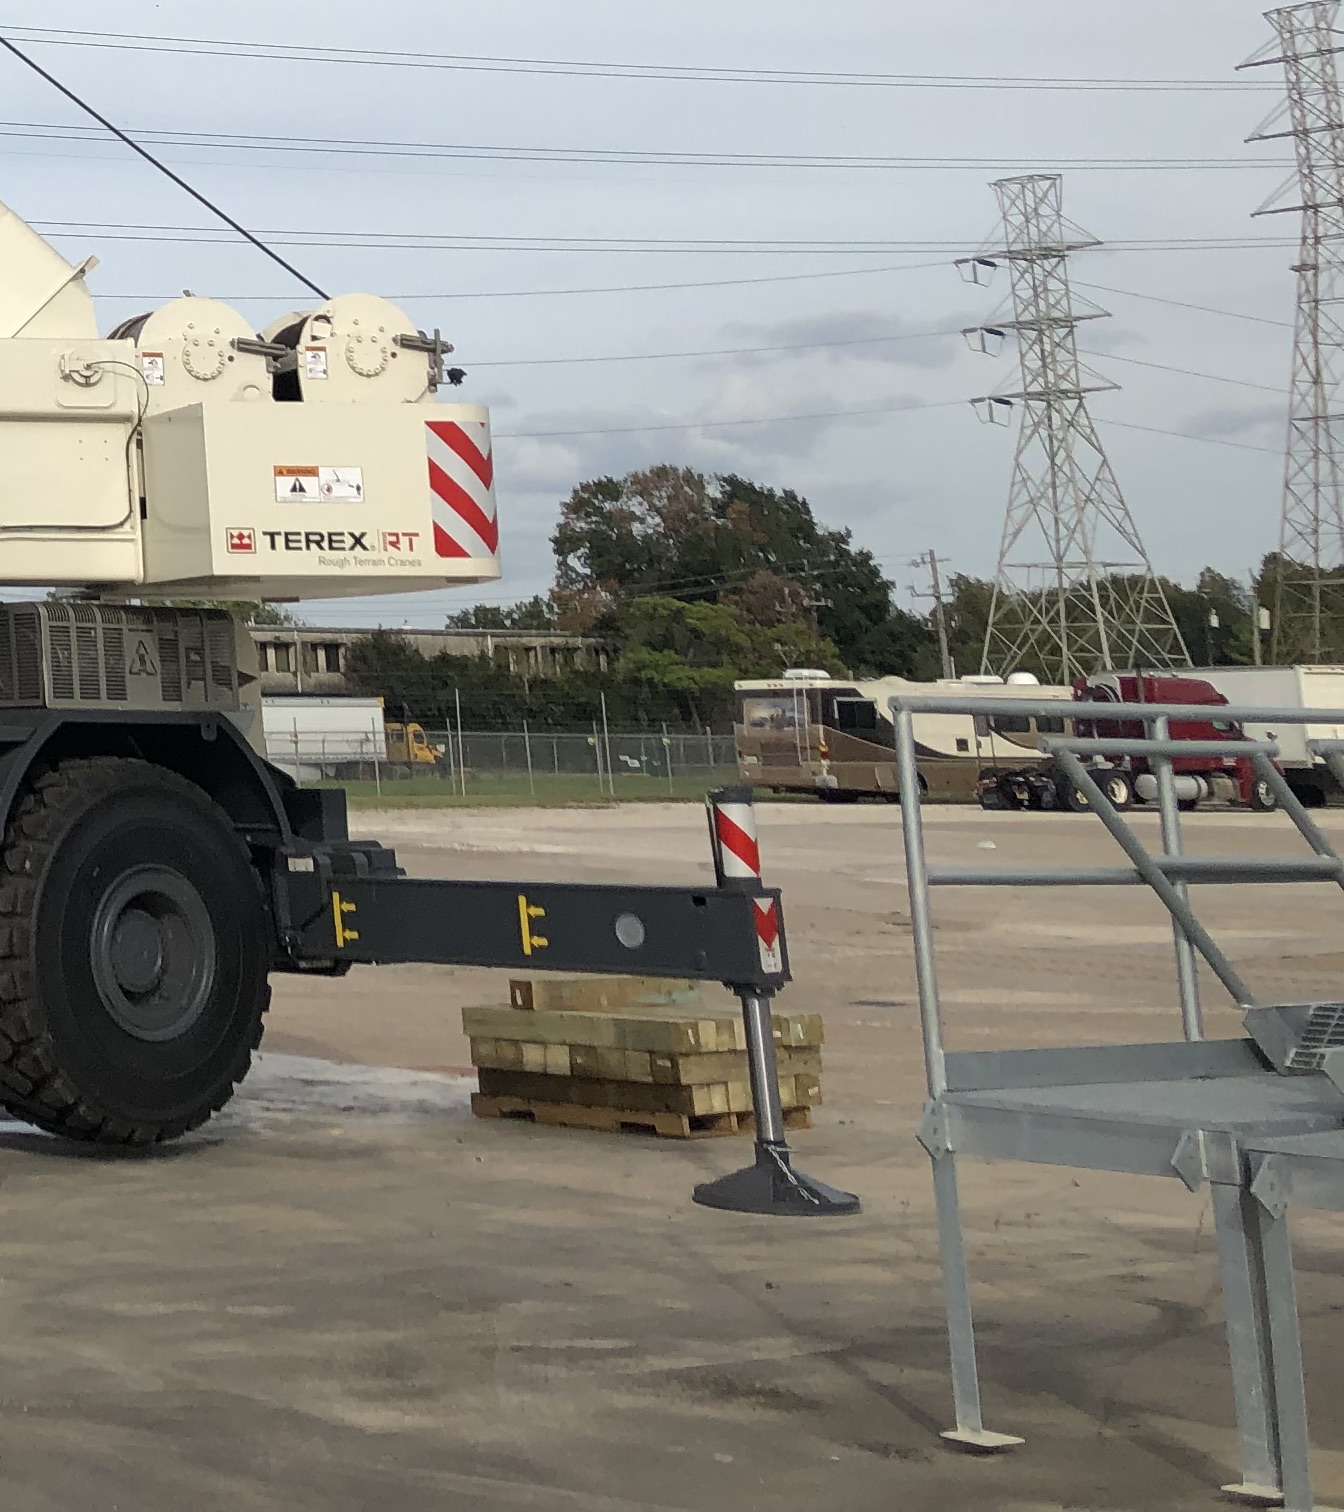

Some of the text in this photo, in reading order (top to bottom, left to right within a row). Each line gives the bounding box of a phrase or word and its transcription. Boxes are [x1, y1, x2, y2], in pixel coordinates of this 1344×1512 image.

[381, 531, 420, 553] RT
[318, 556, 422, 569] Rough Terrain Cranes
